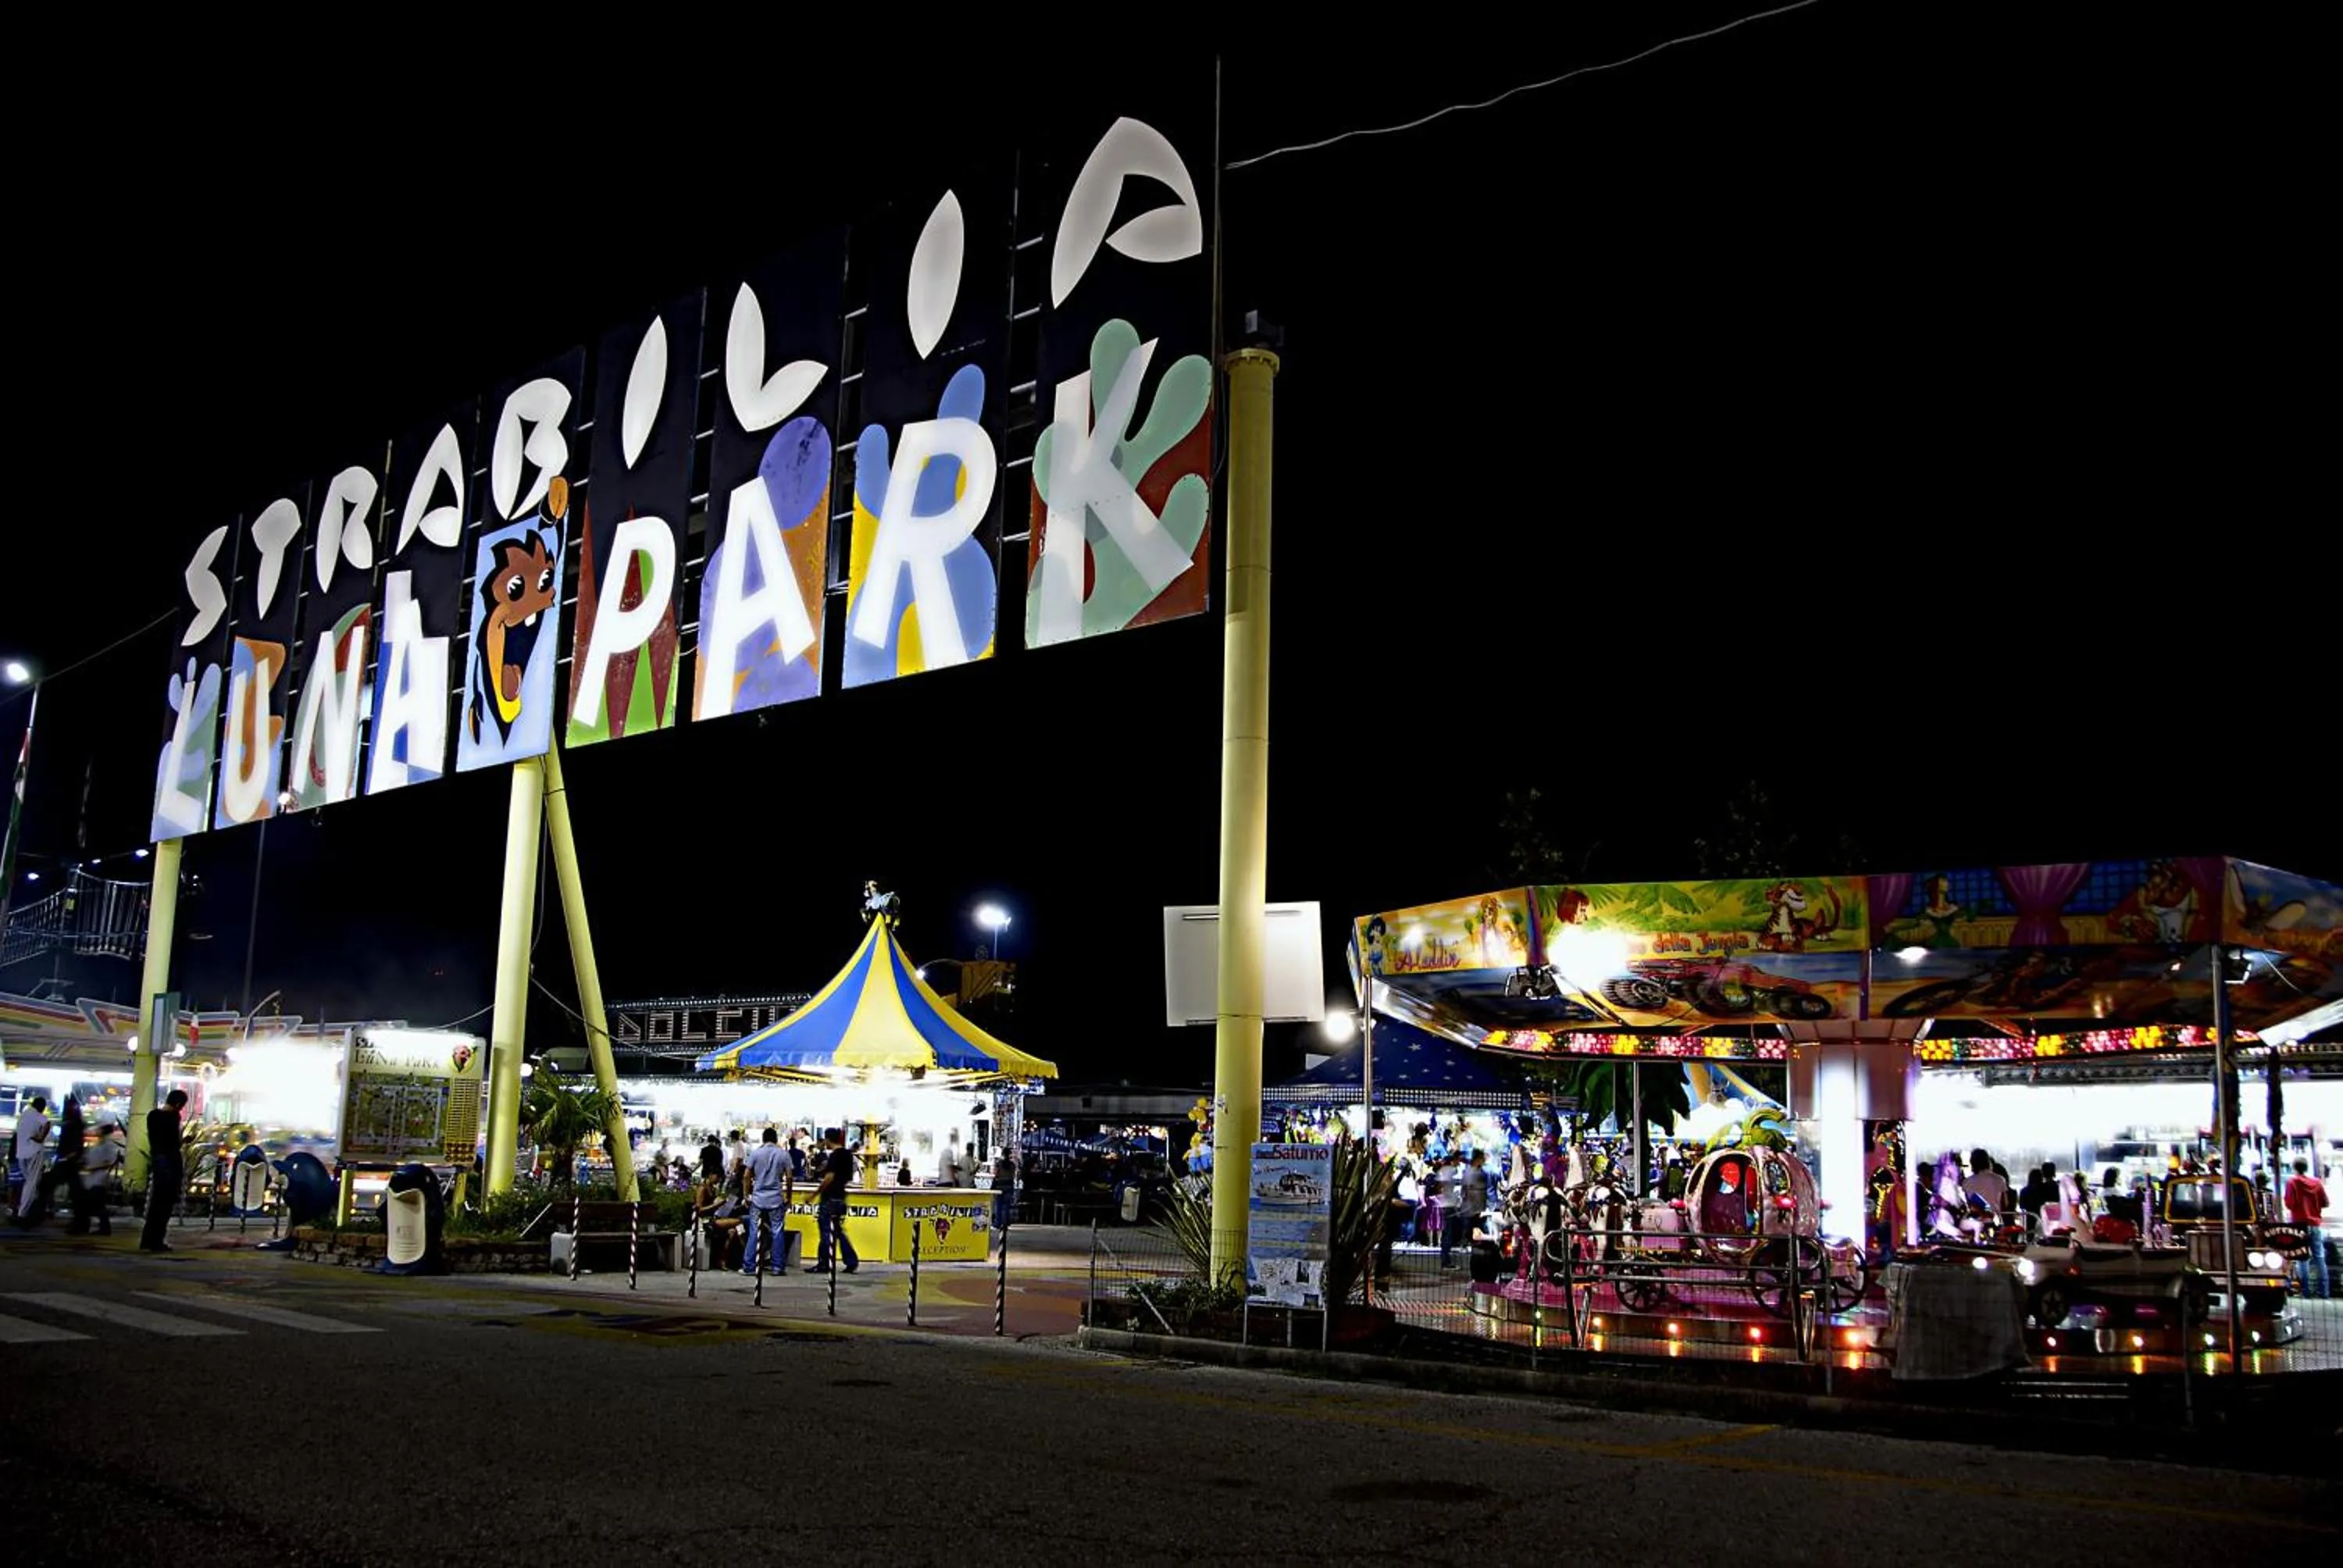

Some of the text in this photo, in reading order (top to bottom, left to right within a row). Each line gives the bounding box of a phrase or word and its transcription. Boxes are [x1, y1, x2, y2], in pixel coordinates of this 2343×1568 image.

[182, 116, 1204, 647] STRABILIA
[157, 337, 1194, 832] LUNA PARK
[918, 1245, 968, 1255] ECEPTION
[1273, 1145, 1328, 1160] Saturno
